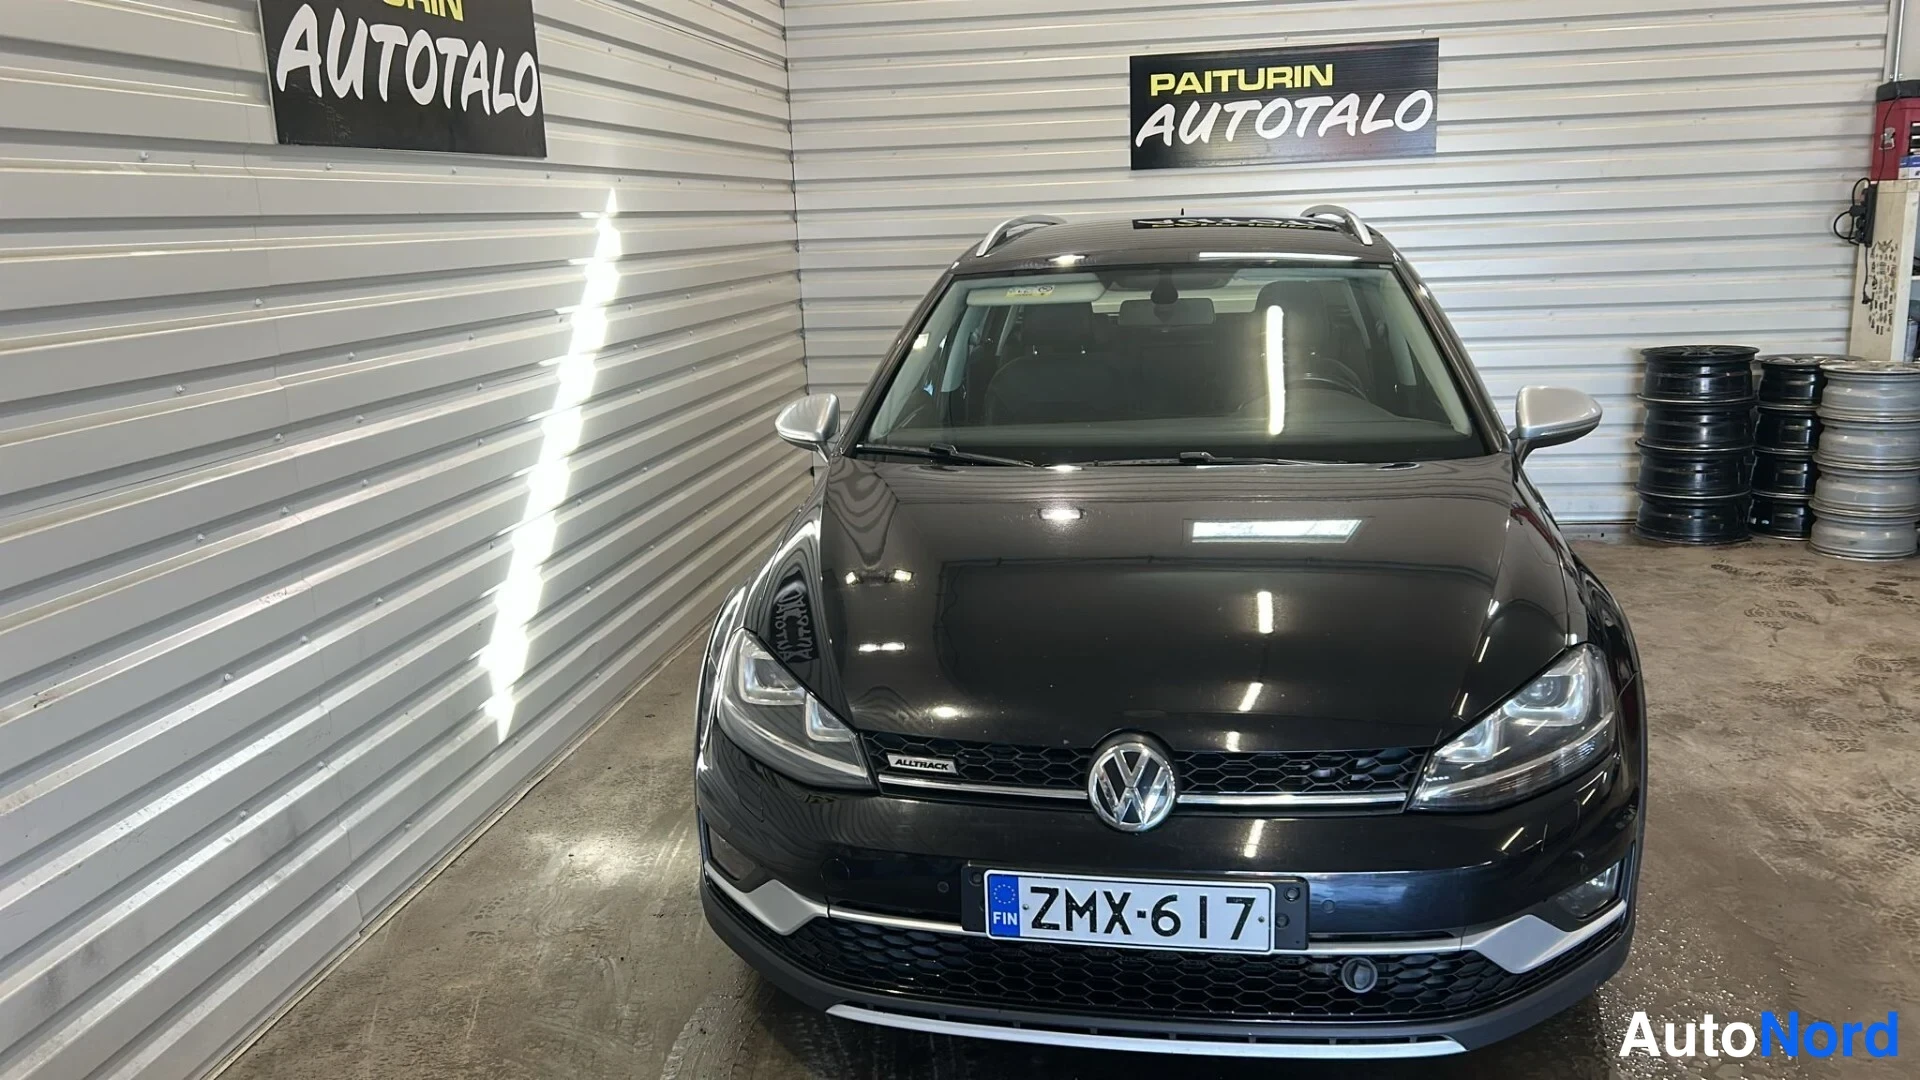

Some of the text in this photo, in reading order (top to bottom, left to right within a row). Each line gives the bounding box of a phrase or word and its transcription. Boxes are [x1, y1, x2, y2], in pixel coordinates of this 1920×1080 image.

[276, 3, 539, 117] AUTOTALO
[1150, 63, 1334, 96] PAITURIN
[1135, 89, 1434, 148] AUTOTALO
[895, 758, 949, 770] ALLTRACK
[993, 911, 1018, 926] FIN
[1030, 886, 1256, 940] ZMX-617
